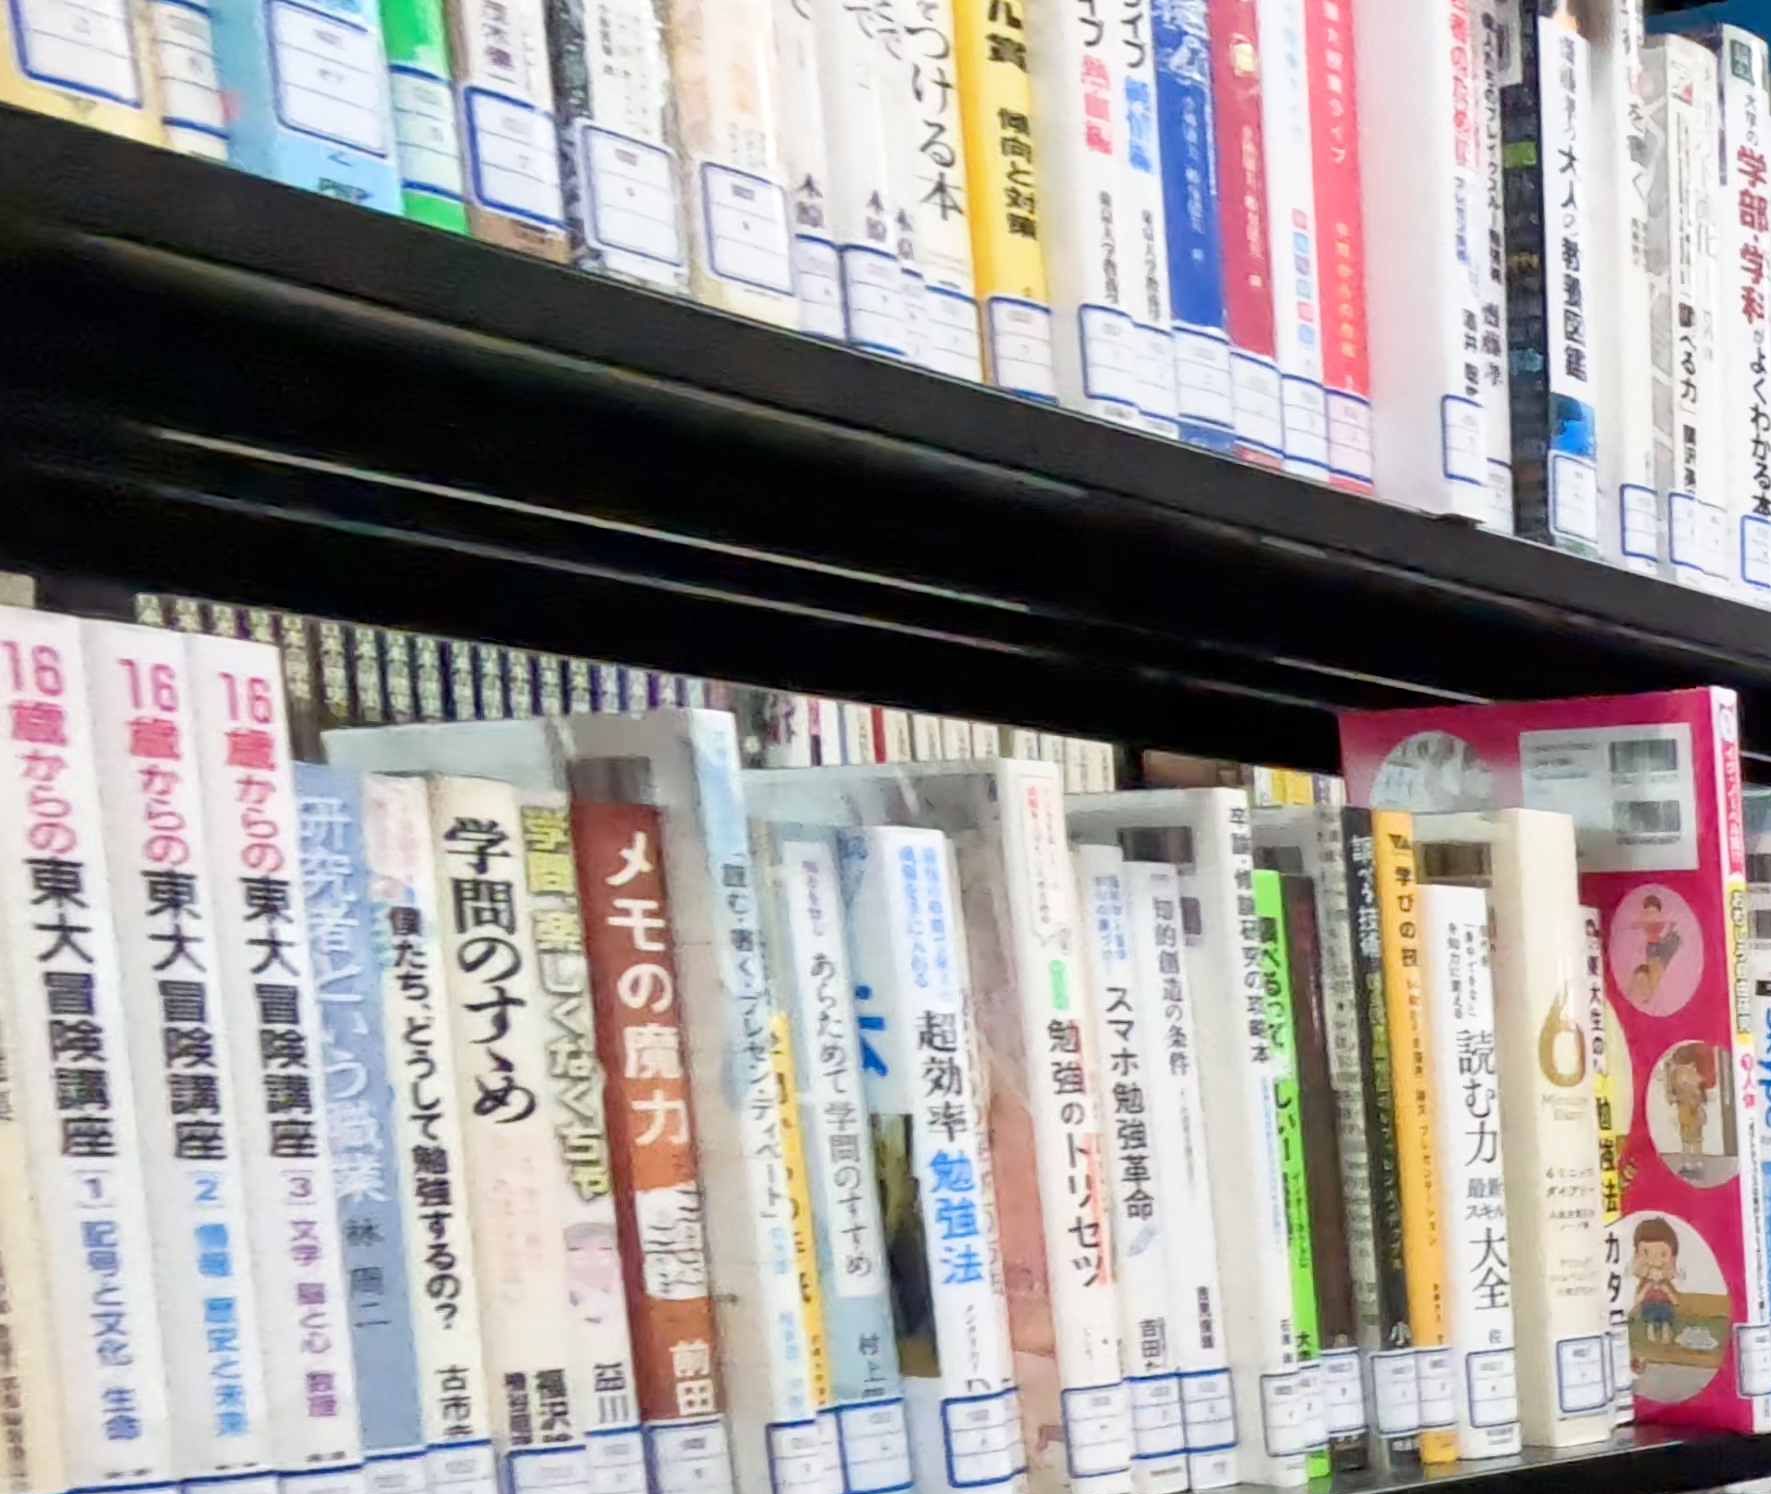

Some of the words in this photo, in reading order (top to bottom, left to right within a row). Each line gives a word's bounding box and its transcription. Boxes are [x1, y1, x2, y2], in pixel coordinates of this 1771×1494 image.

[442, 815, 538, 1126] 学問のすすめ
[604, 829, 692, 1149] メモの魔力
[1103, 985, 1156, 1222] スマホ勉強革命
[914, 1009, 984, 1285] 超効率勉強法
[1046, 1017, 1103, 1290] 勉強のトリセツ
